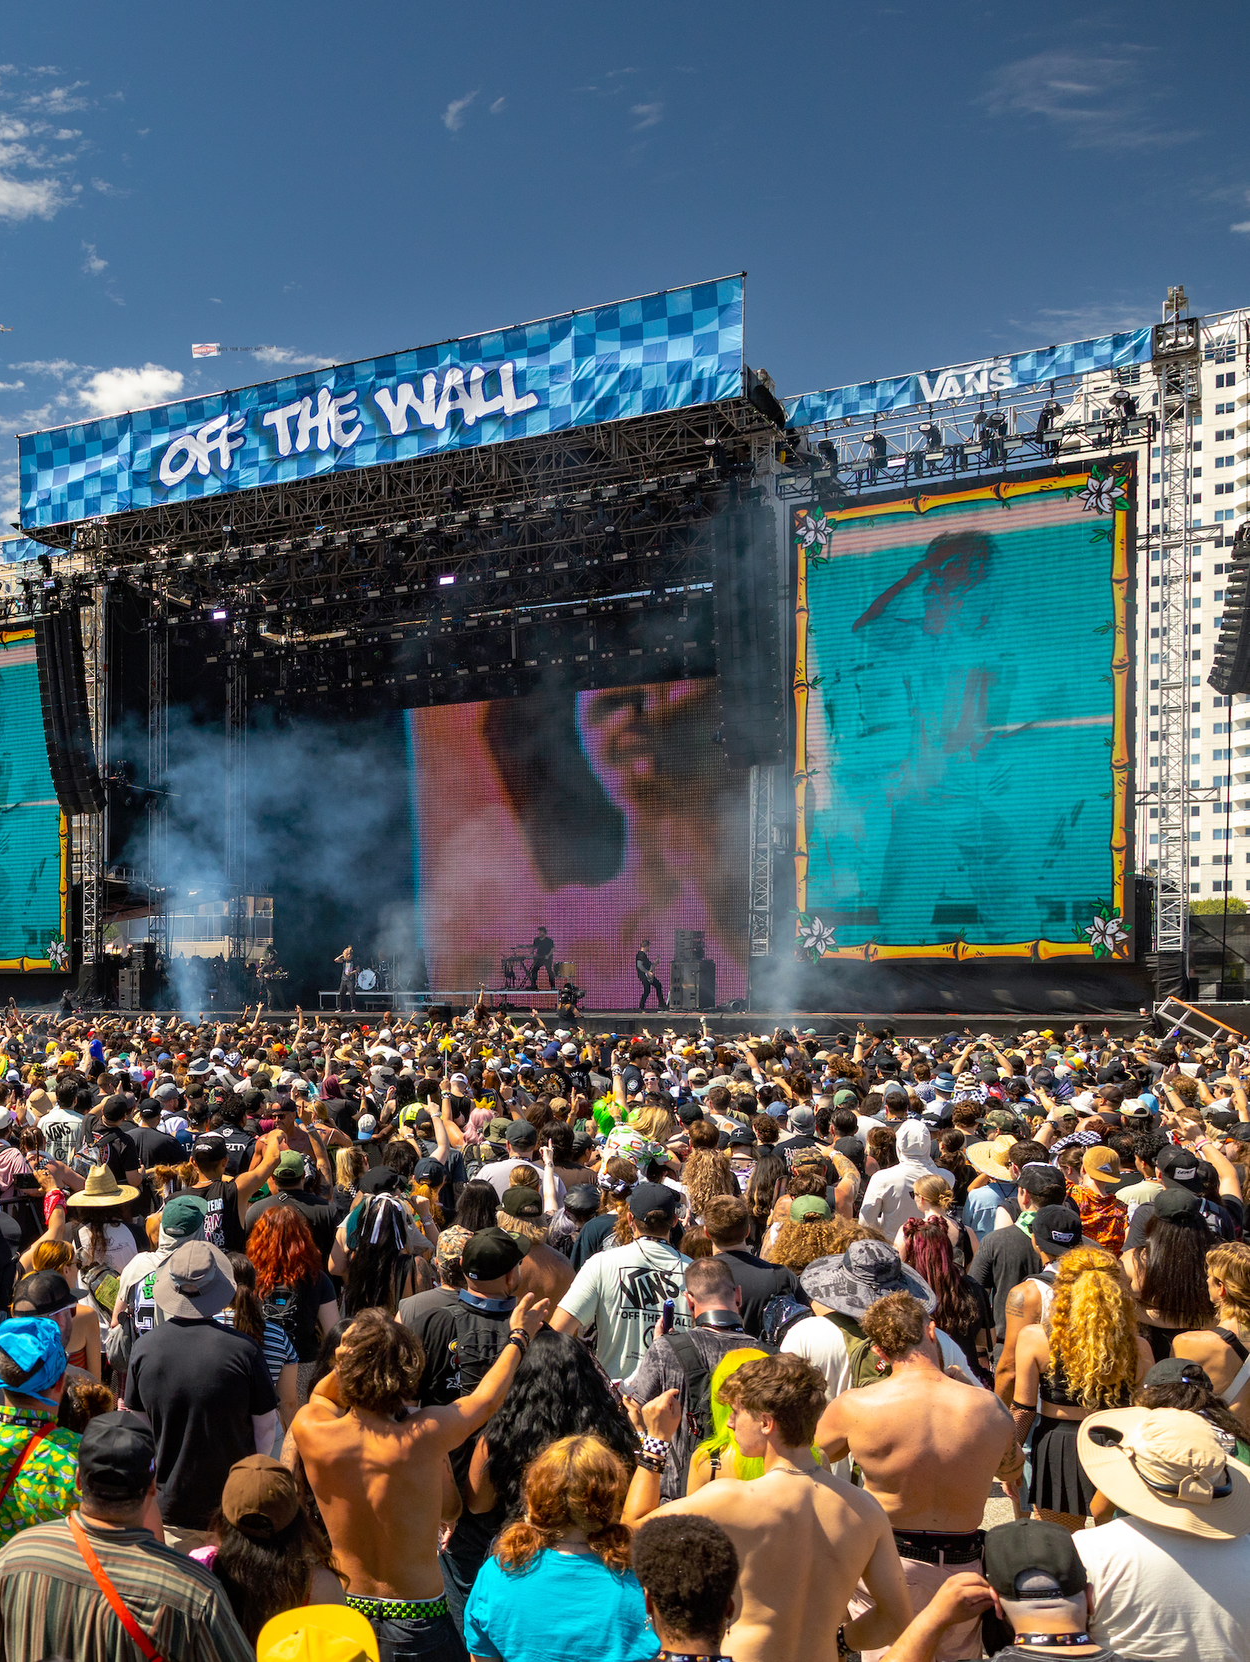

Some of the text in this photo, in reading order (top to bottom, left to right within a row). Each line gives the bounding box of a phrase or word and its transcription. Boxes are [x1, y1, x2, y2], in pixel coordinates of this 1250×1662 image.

[916, 357, 1013, 403] VANS
[158, 360, 539, 488] OFF THE WALL
[45, 1121, 72, 1142] VANS
[225, 1143, 247, 1151] RITY
[620, 1266, 680, 1310] VANS
[672, 1317, 692, 1328] ALL
